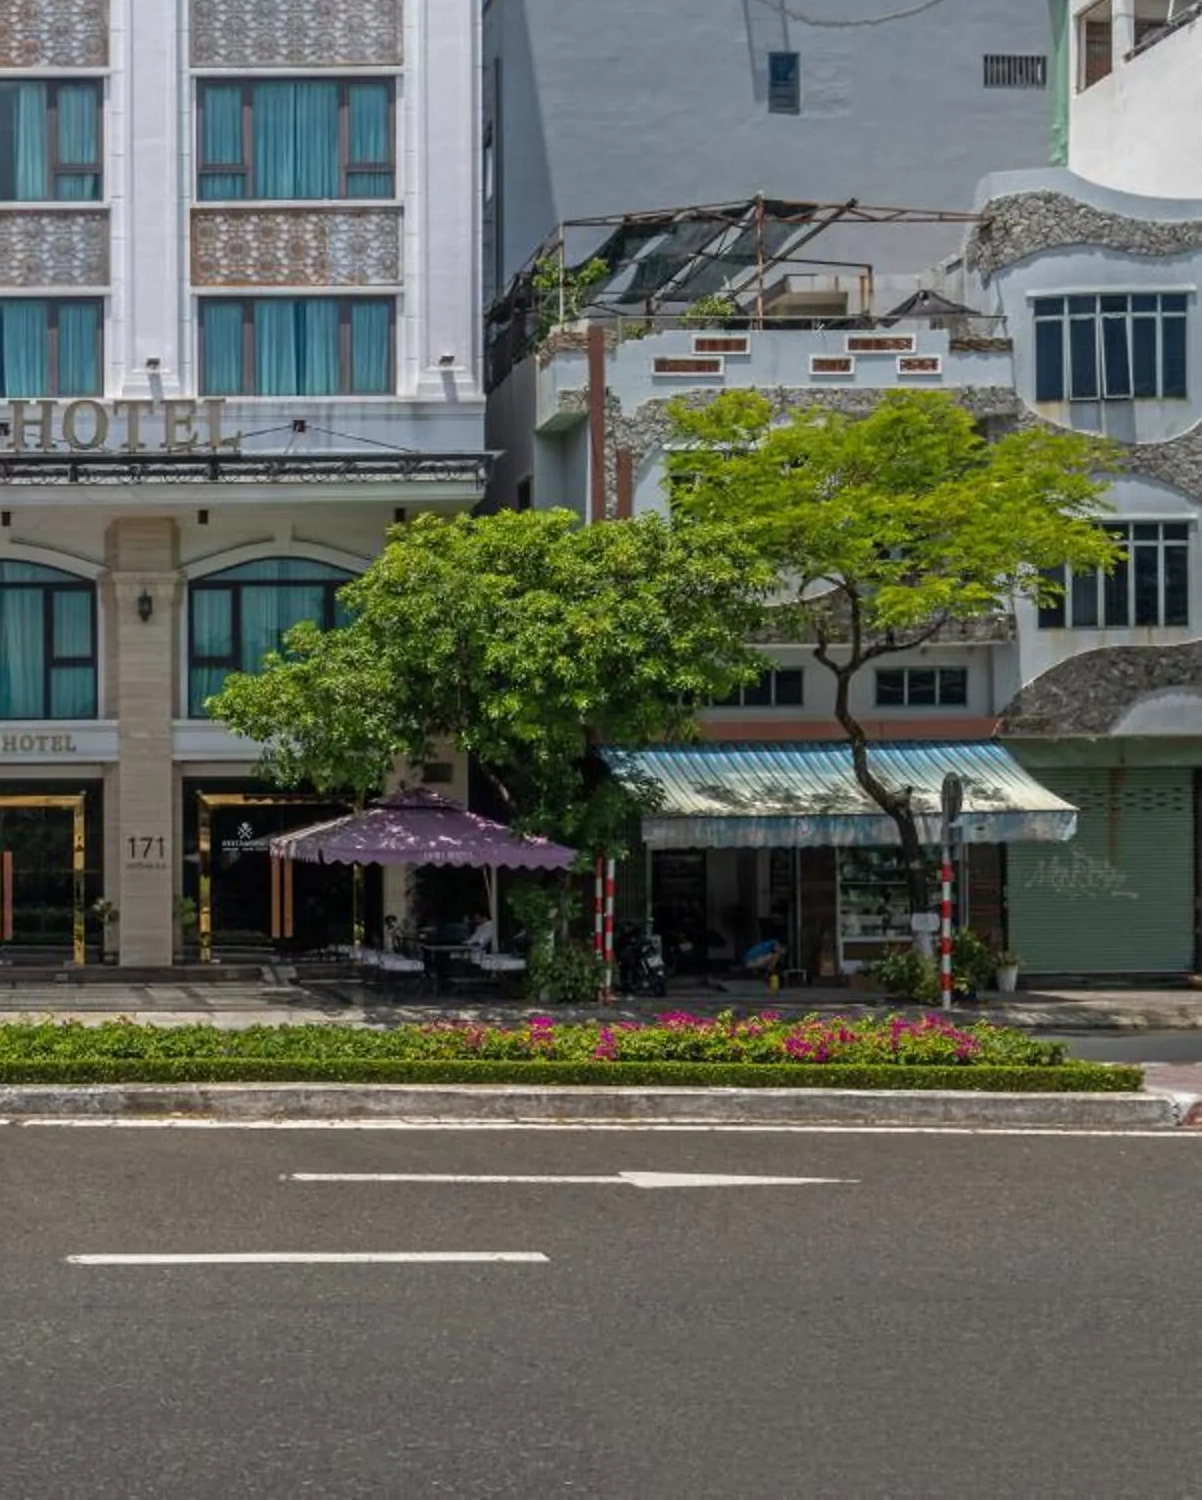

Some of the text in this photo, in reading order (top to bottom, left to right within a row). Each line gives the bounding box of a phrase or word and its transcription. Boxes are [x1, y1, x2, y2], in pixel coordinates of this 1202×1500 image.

[5, 398, 242, 451] HOTEL
[2, 733, 77, 753] HOTEL
[128, 836, 164, 859] 171
